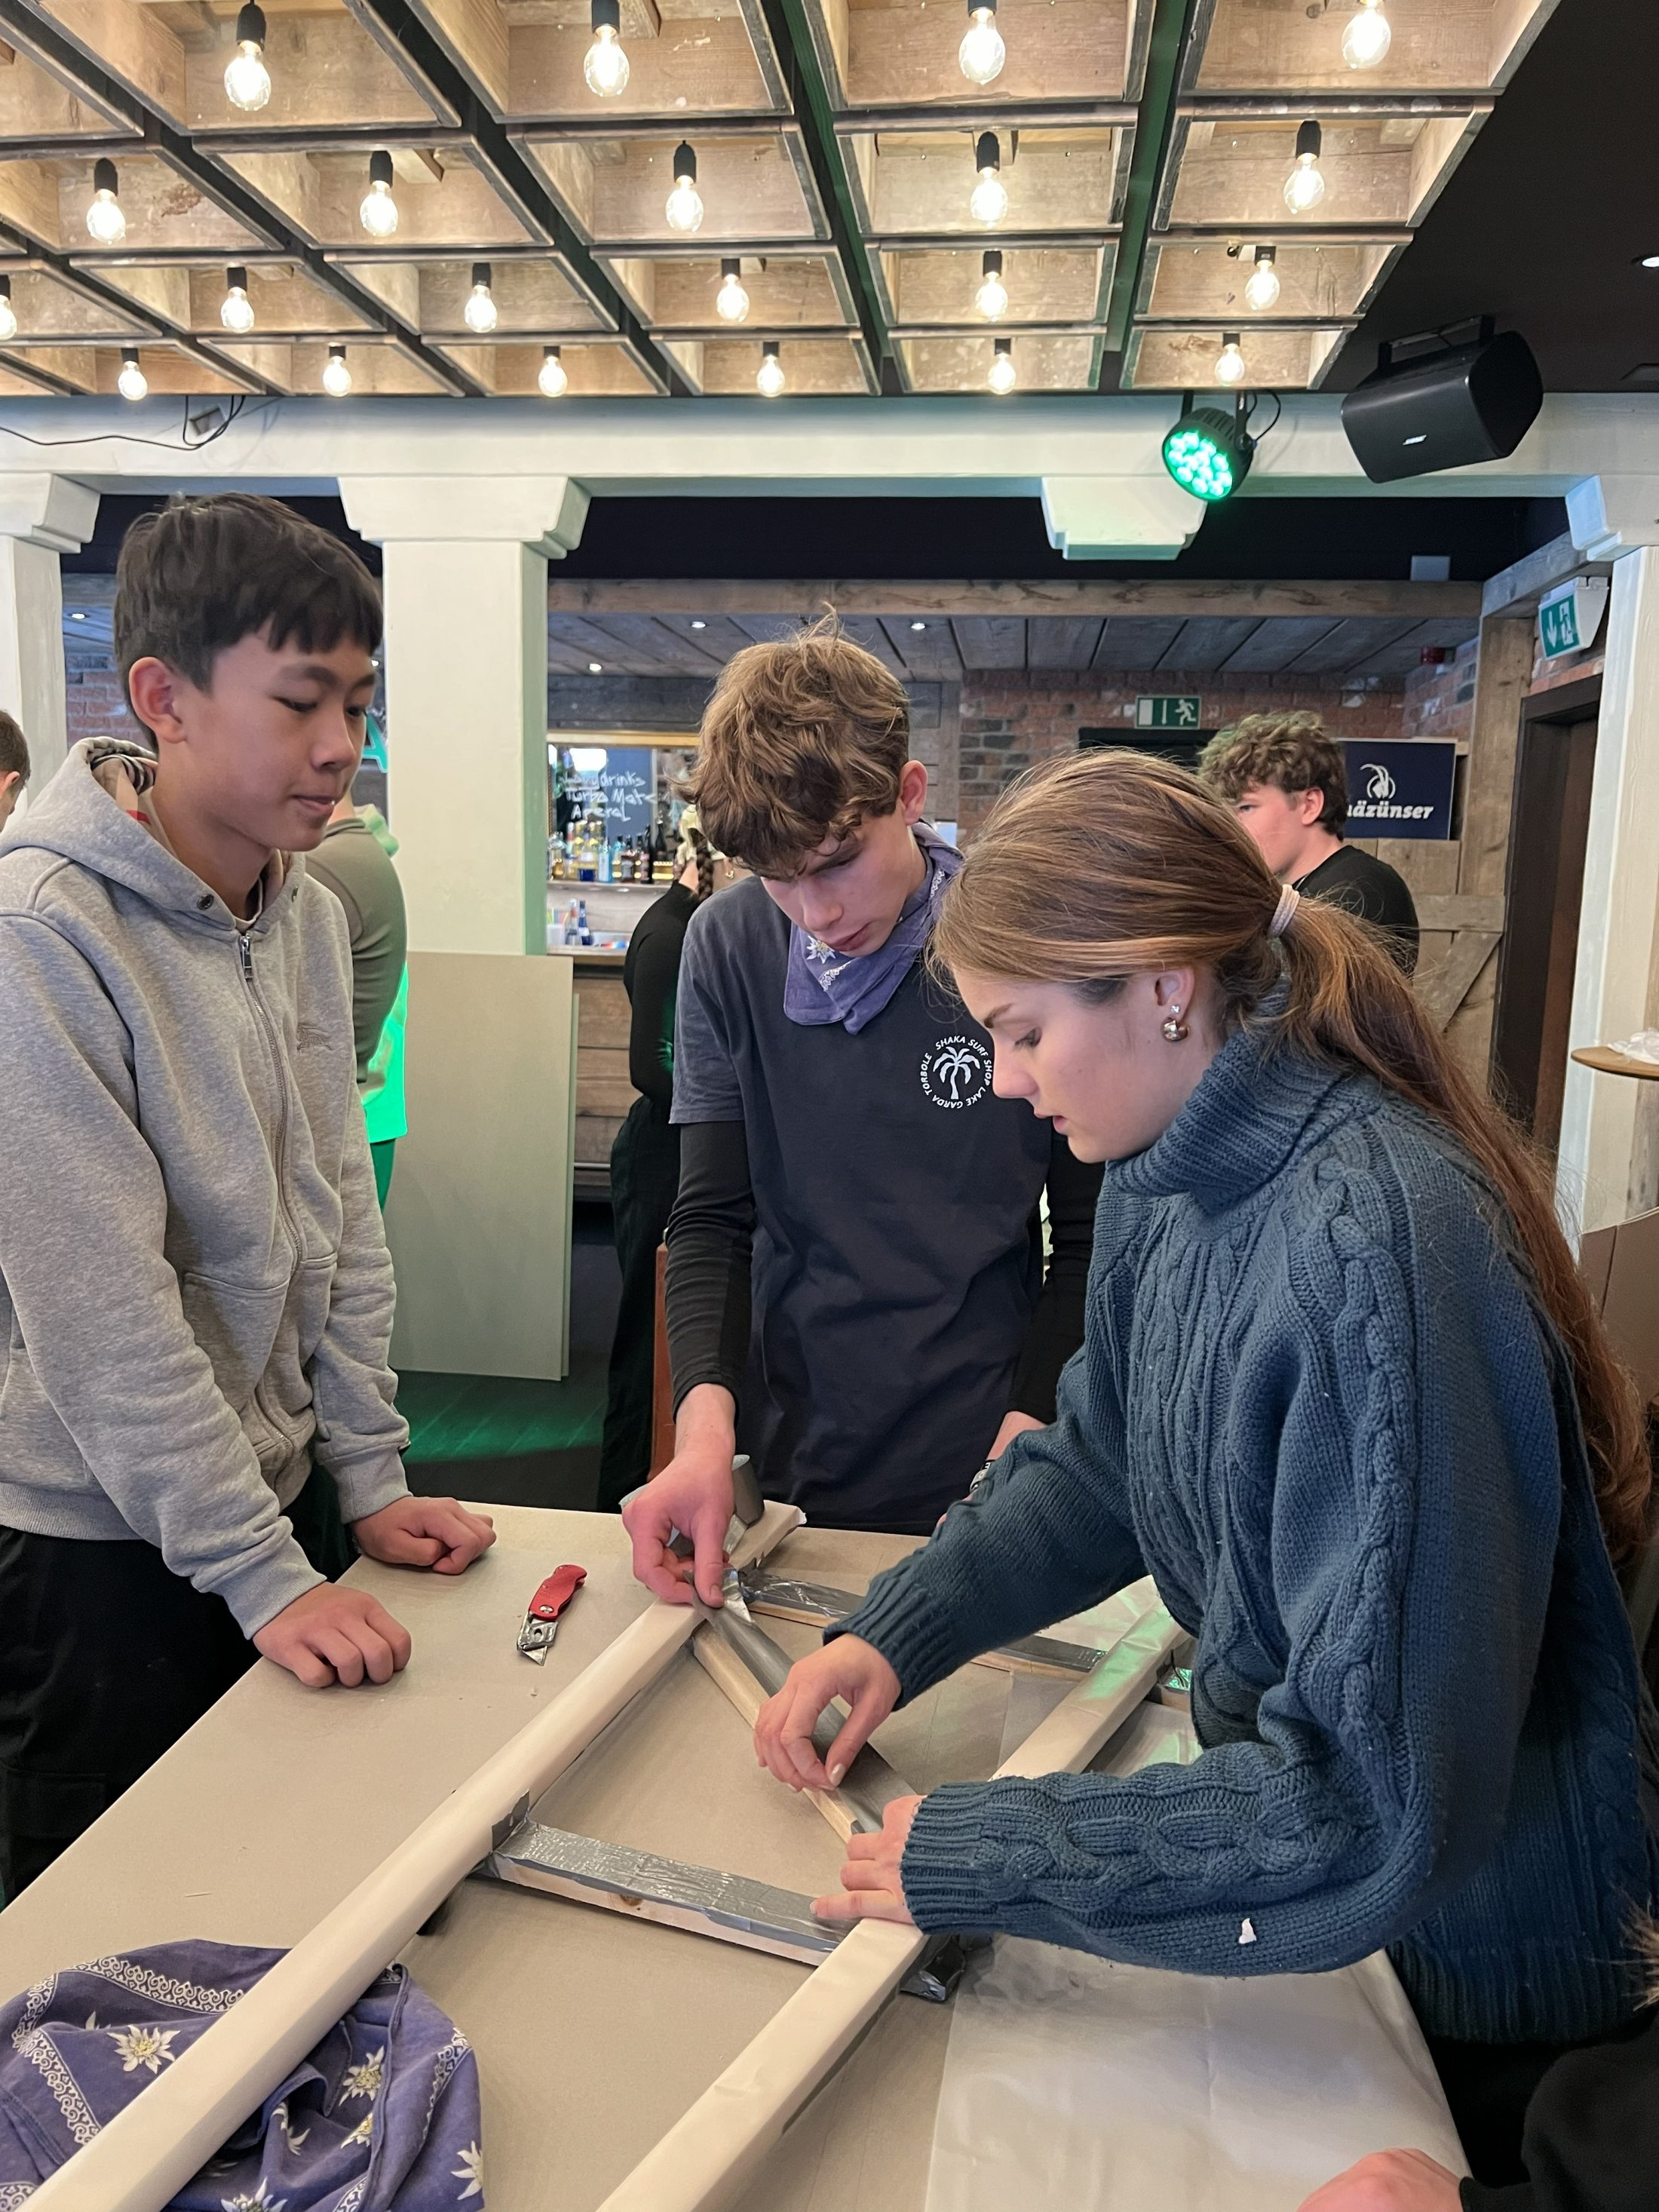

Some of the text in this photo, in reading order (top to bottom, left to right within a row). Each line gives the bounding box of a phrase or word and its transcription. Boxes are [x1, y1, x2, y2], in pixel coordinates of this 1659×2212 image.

[920, 1035, 993, 1109] SHAKA SURF SHOP LAKE GARDA TORBOLE
